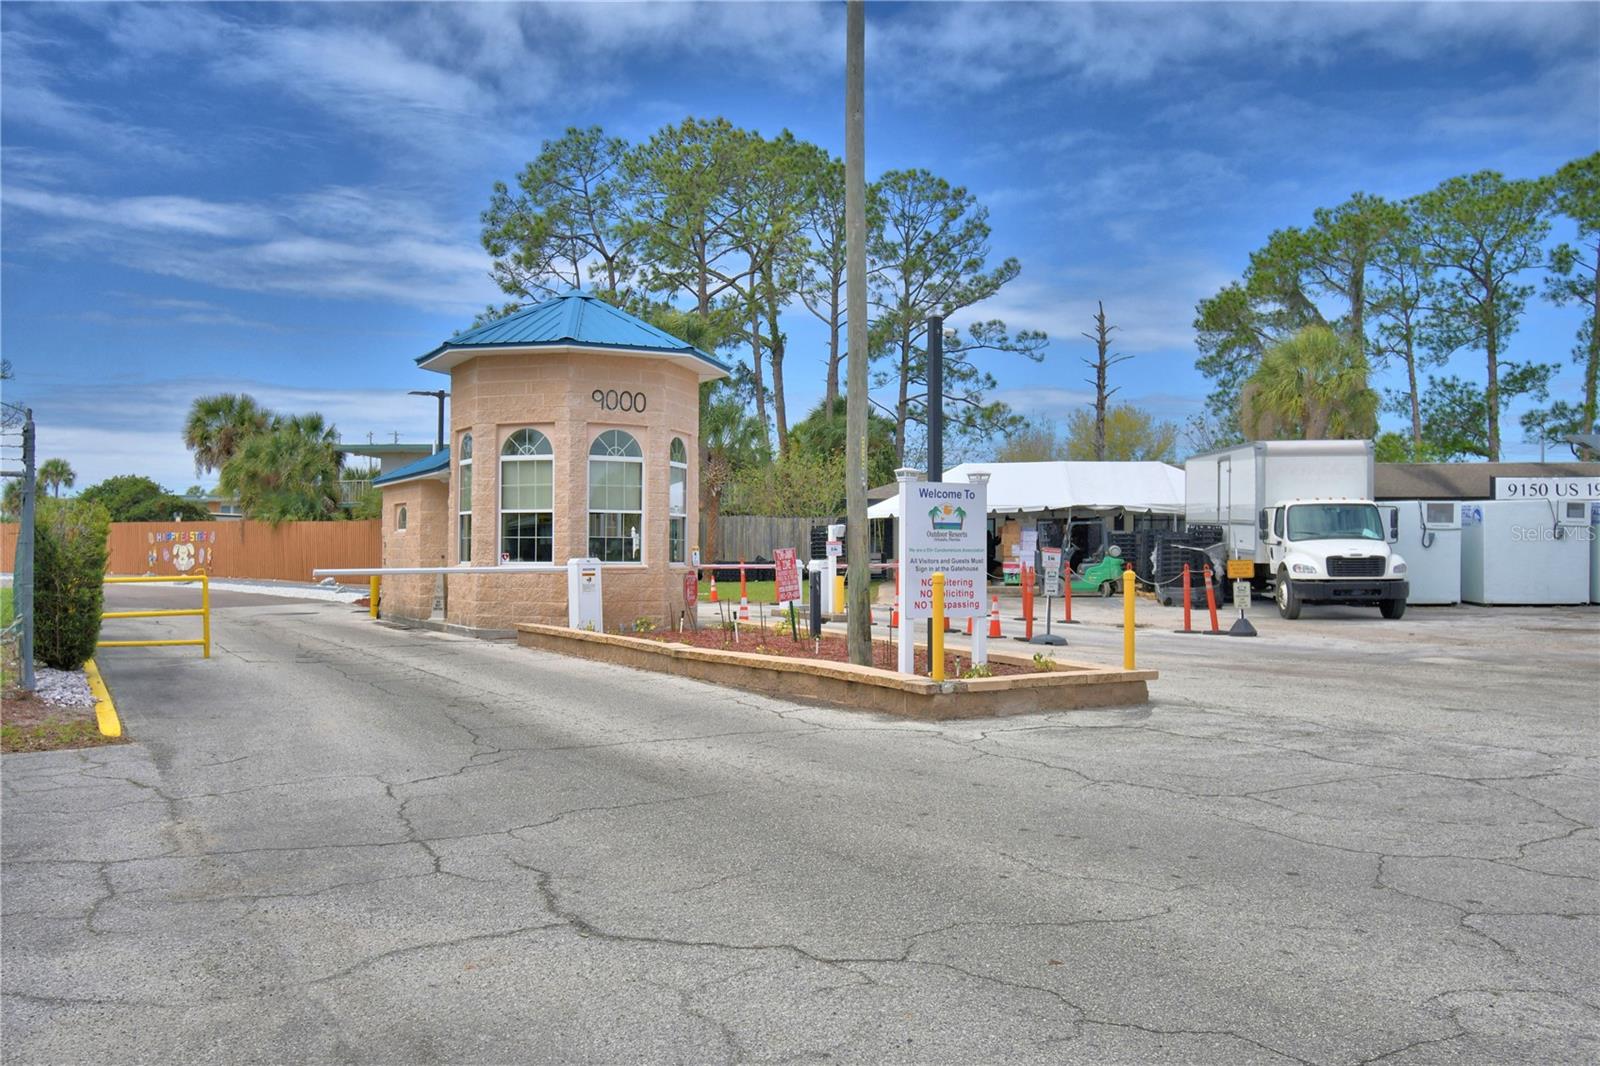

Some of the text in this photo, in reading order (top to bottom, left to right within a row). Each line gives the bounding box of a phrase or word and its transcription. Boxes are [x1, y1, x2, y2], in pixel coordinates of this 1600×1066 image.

[591, 389, 647, 413] 9000
[918, 488, 976, 500] Welcome To
[1508, 483, 1548, 497] 9150
[1556, 483, 1579, 497] US
[920, 589, 974, 599] NO liciting
[914, 600, 980, 609] NO Tspassing
